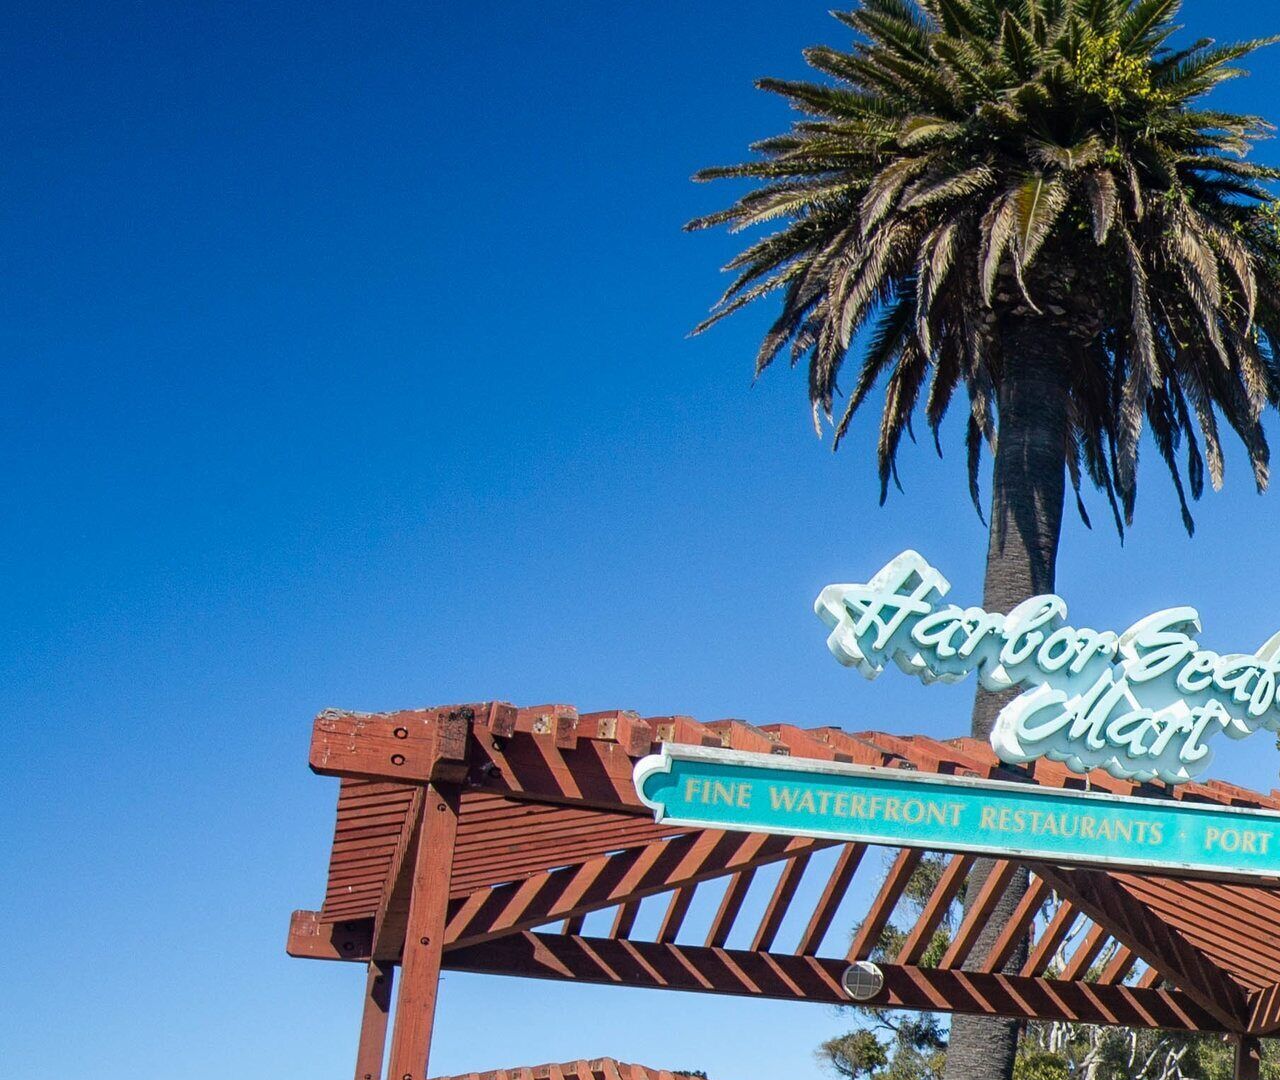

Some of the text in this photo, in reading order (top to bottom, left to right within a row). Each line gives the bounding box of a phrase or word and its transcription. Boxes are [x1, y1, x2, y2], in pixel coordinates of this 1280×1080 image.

[820, 552, 1119, 682] Harbor
[1002, 673, 1226, 768] Mart
[685, 777, 751, 807] FINE
[770, 786, 964, 828] WATERFRONT
[981, 807, 1164, 845] RESTAURANTS
[1204, 827, 1272, 855] PORT
